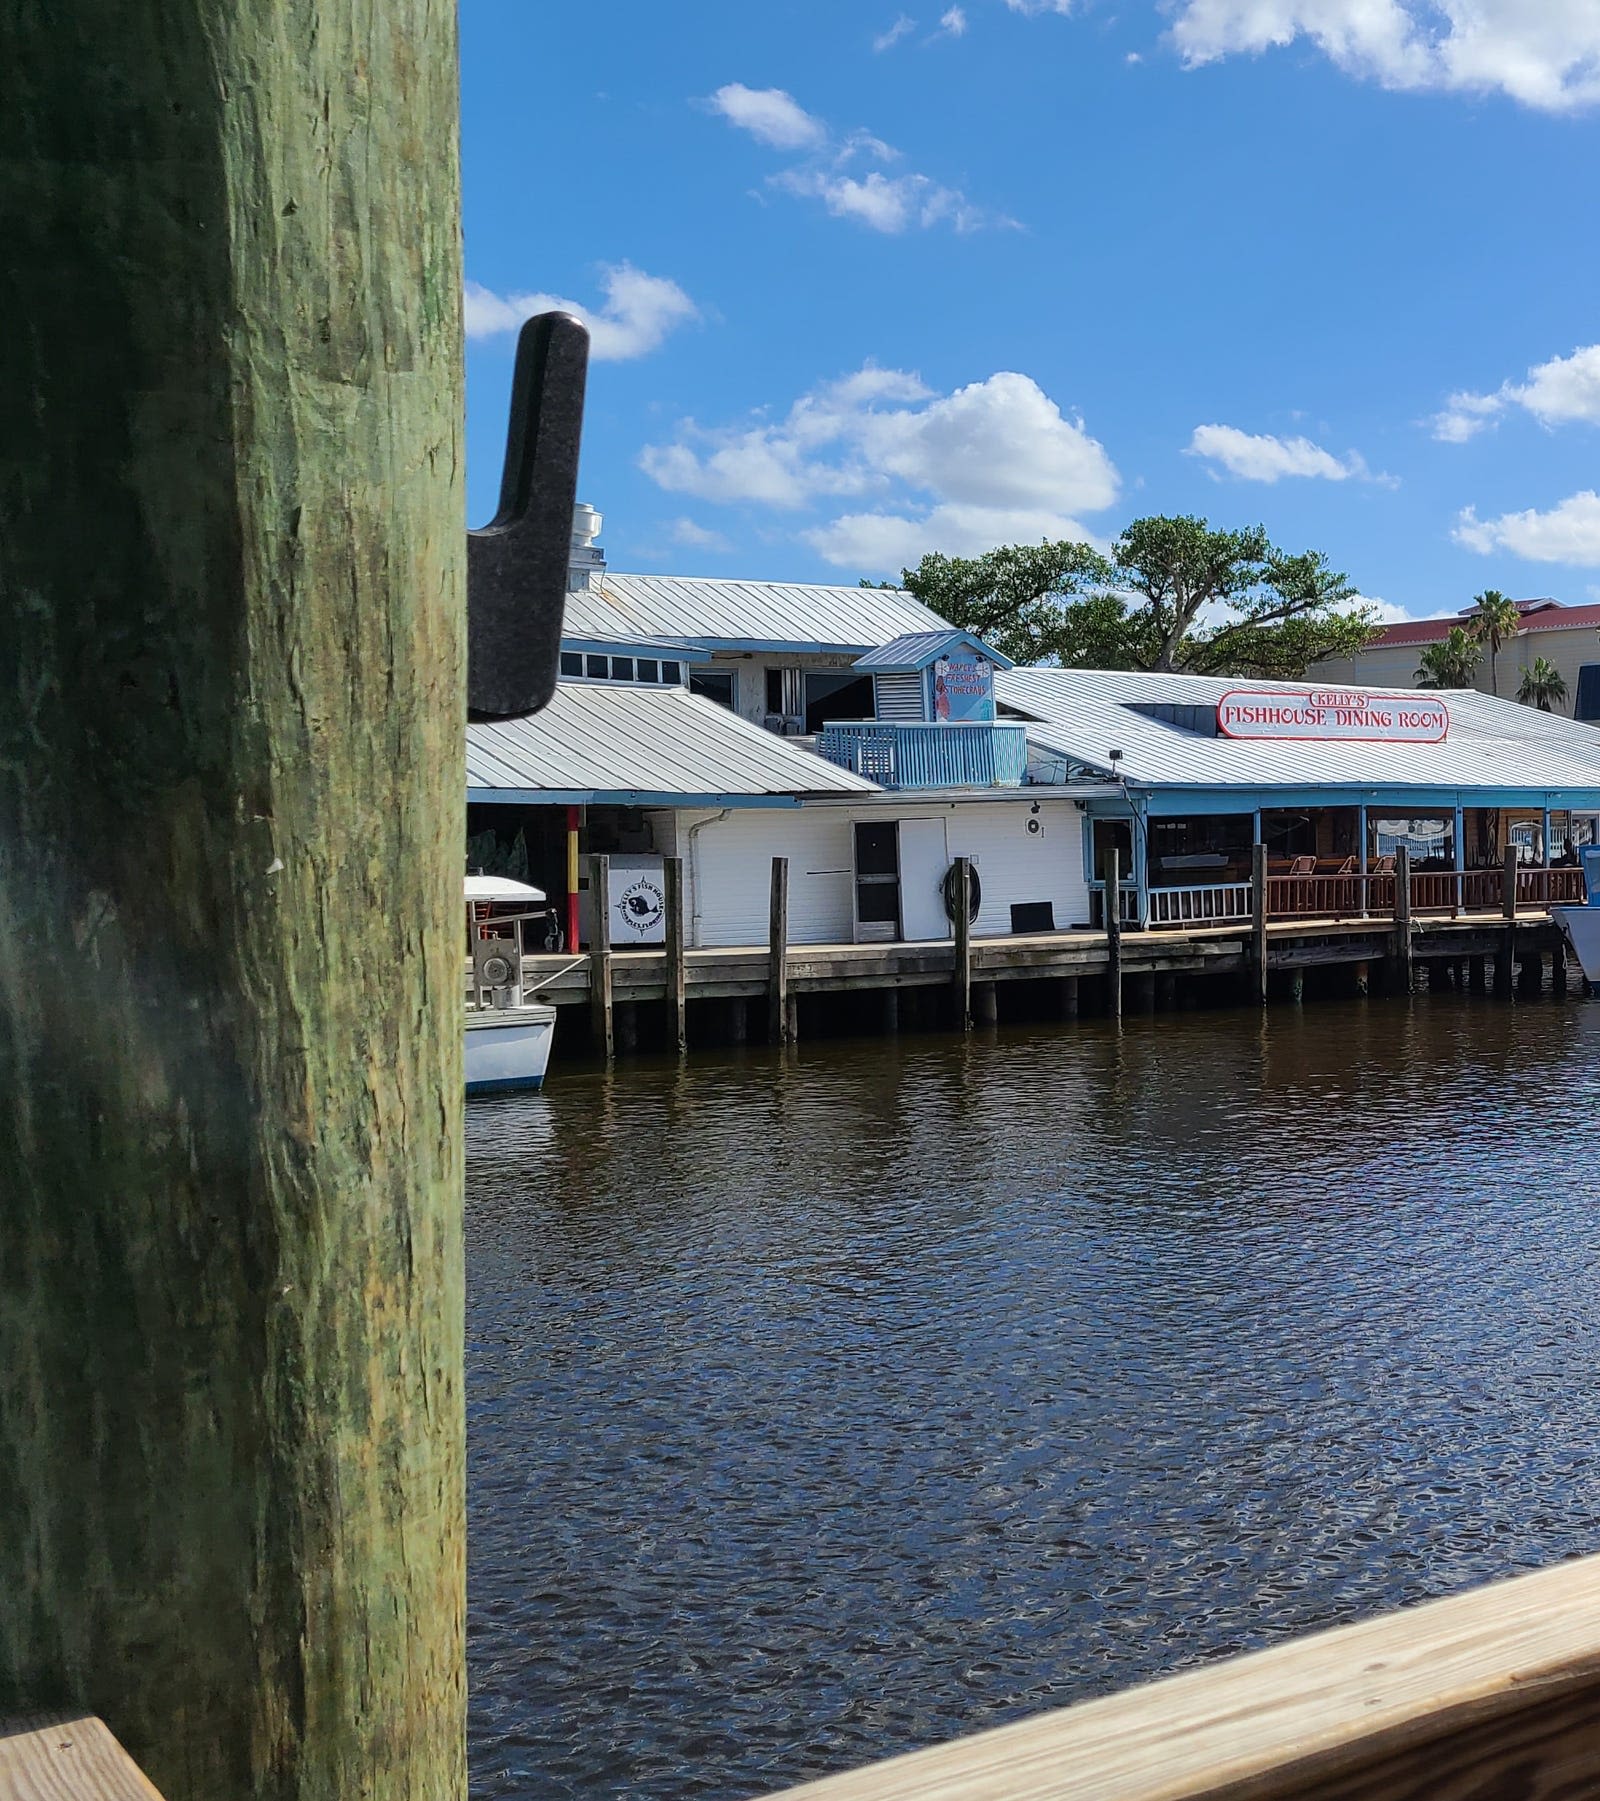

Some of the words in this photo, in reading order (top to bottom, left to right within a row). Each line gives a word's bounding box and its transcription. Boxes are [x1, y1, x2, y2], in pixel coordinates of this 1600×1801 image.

[1318, 693, 1365, 707] KELLY'S
[1224, 706, 1328, 726] FISHHOUSE
[1336, 710, 1392, 727] DINING
[1399, 712, 1444, 728] ROOM
